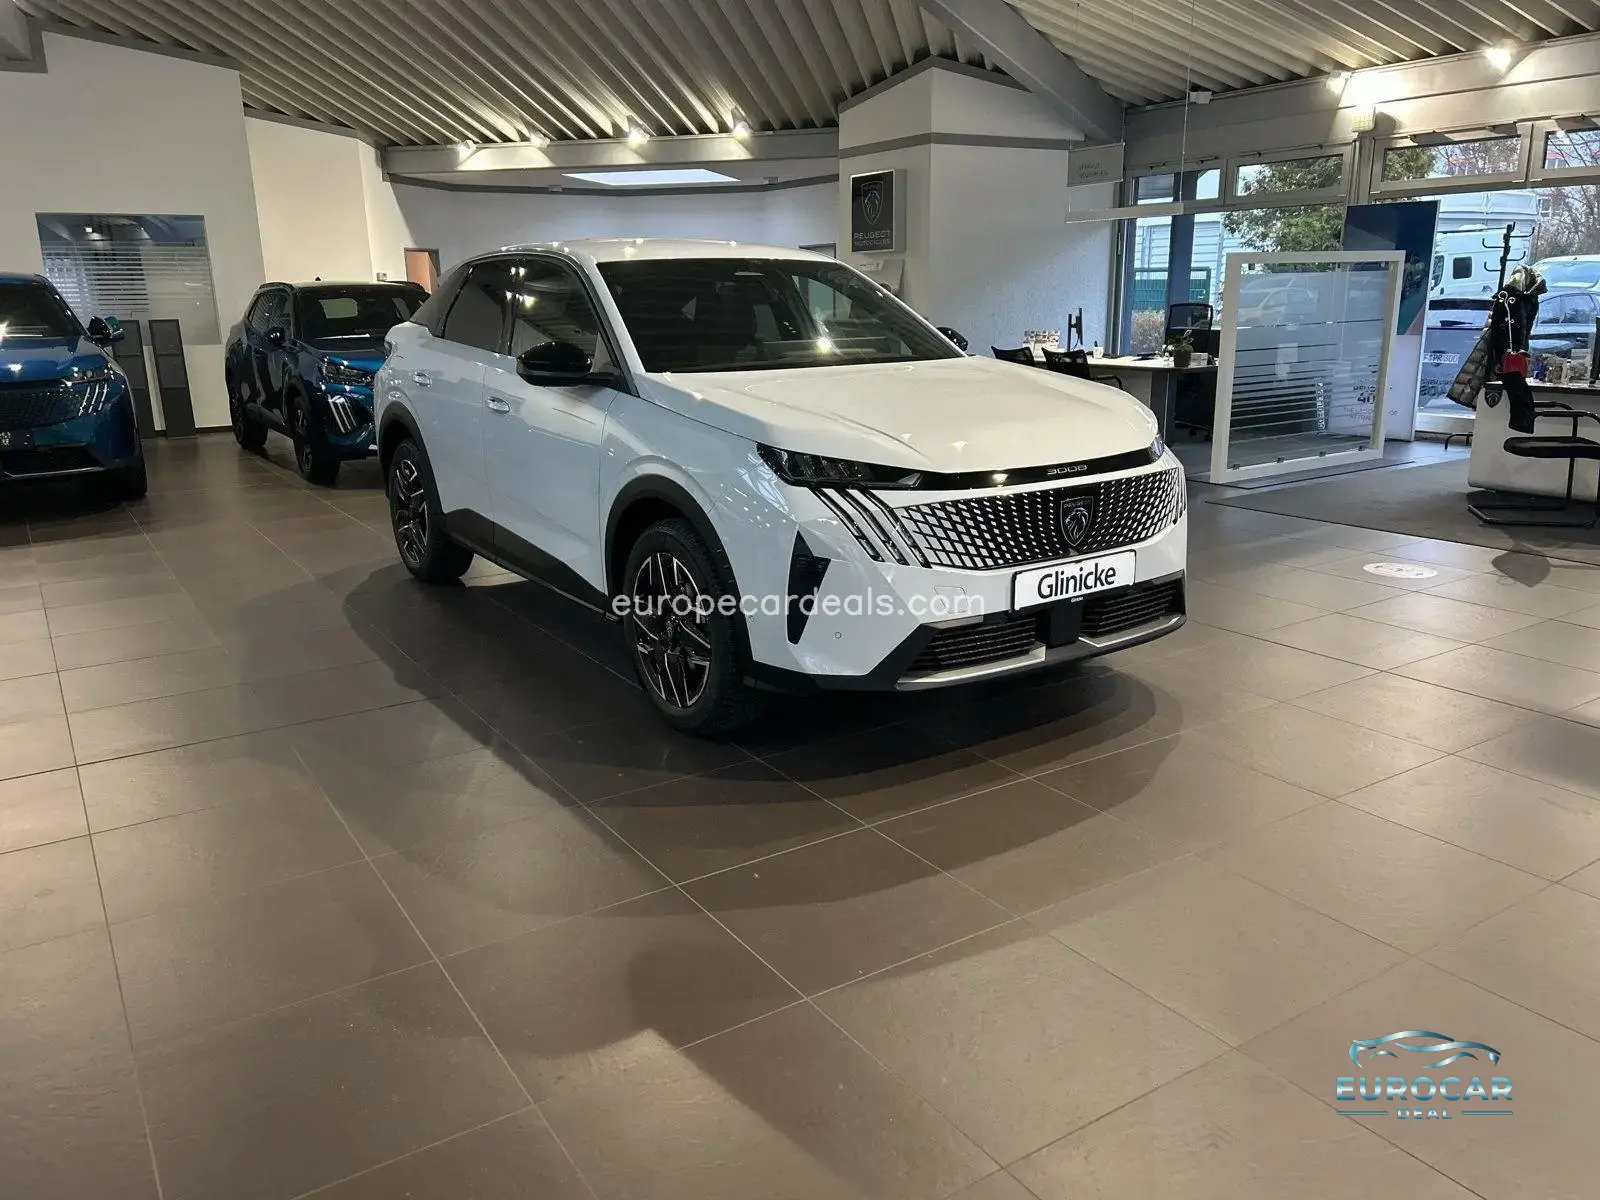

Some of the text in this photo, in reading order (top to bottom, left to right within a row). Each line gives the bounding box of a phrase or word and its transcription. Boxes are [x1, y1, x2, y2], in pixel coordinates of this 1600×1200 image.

[854, 230, 891, 240] PEUGEOT
[1046, 464, 1088, 476] 3008
[1063, 499, 1091, 509] PEUGEOT
[1037, 562, 1117, 599] Glinicke
